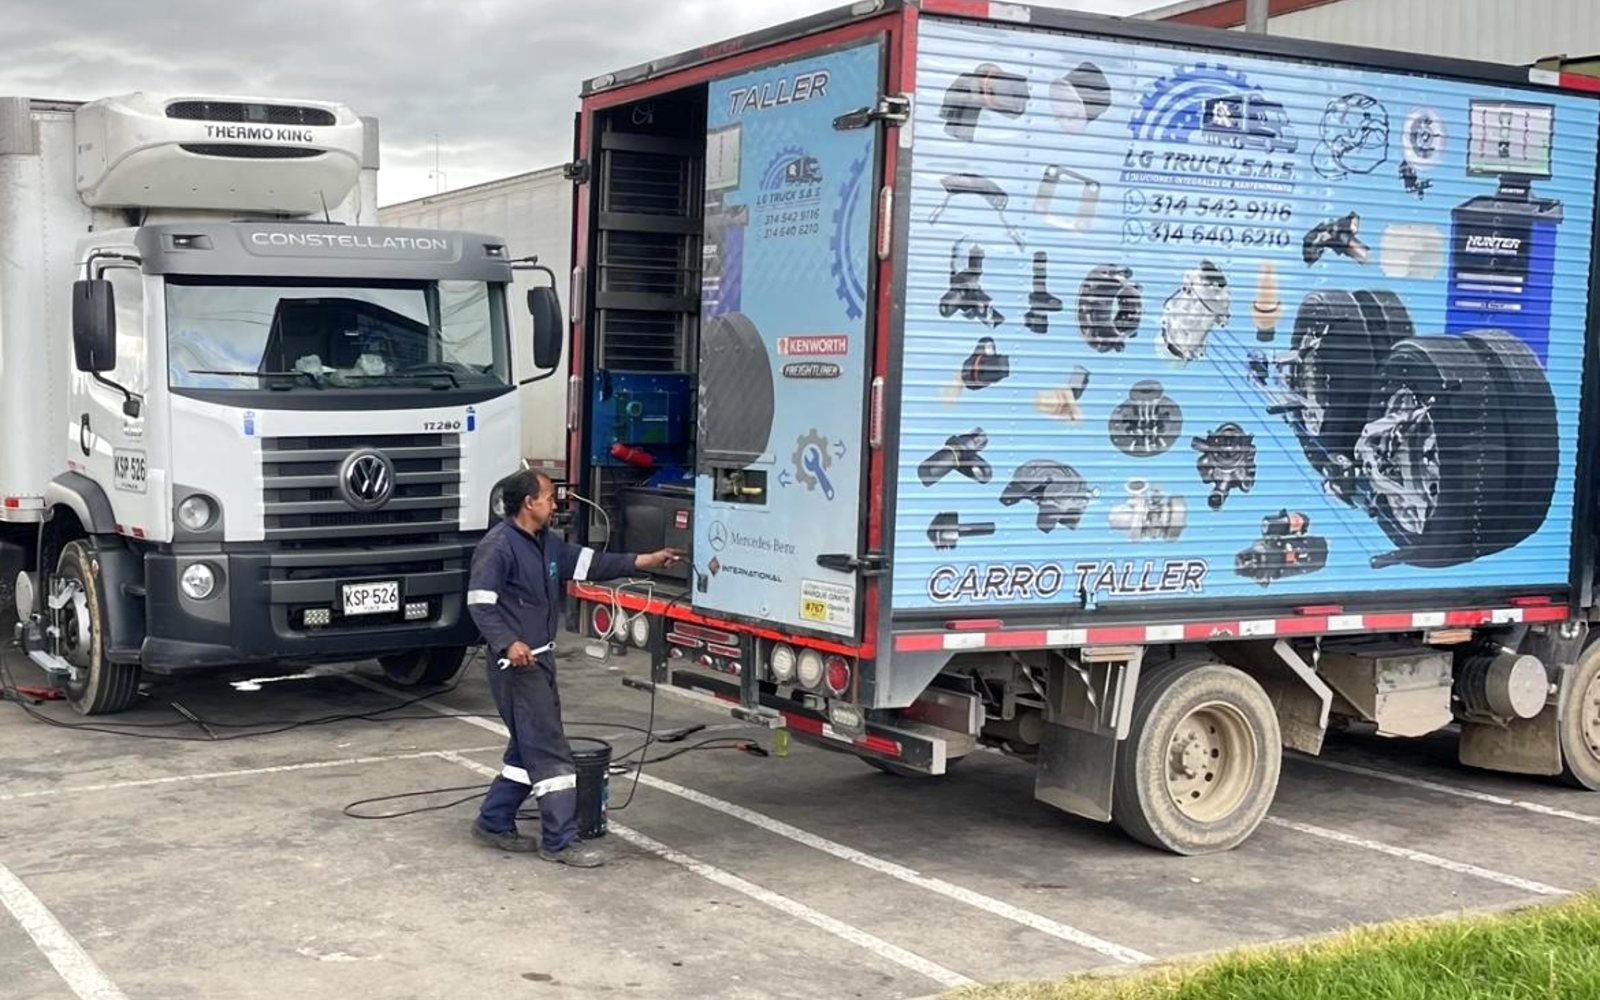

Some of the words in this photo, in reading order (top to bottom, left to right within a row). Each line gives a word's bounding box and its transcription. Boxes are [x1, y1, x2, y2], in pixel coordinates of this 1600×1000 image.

[728, 70, 830, 115] TALLER
[205, 125, 274, 140] THERMO
[277, 129, 313, 142] KING
[1123, 149, 1153, 168] LG
[1162, 152, 1235, 174] TRUCK
[1175, 177, 1220, 187] INTEGRALES
[1222, 180, 1231, 188] DE
[1233, 181, 1294, 193] MANTENIMIENTO
[770, 190, 797, 203] TRUCK
[765, 214, 780, 225] 314
[780, 211, 798, 223] 542
[800, 208, 820, 221] 9116
[1150, 194, 1187, 214] 314
[1195, 197, 1238, 218] 542
[1245, 201, 1292, 222] 9116
[764, 228, 778, 239] 314
[779, 225, 797, 237] 640
[799, 223, 819, 235] 6210
[1149, 222, 1184, 244] 314
[1192, 225, 1234, 247] 640
[1241, 228, 1290, 248] 6210
[252, 232, 447, 250] CONSTELLATION
[1466, 235, 1521, 250] HUNTER
[790, 337, 847, 352] KENWORTH
[784, 363, 838, 377] FREIGHTLINER
[114, 456, 129, 479] KSP
[131, 458, 146, 482] 526
[731, 532, 796, 555] Mercedes-Benz
[722, 565, 782, 583] INTERNATIONAL
[928, 564, 1062, 602] CARRO
[1074, 559, 1208, 598] TALLER
[345, 590, 370, 607] KSP
[373, 587, 397, 605] 526
[805, 602, 824, 613] #767
